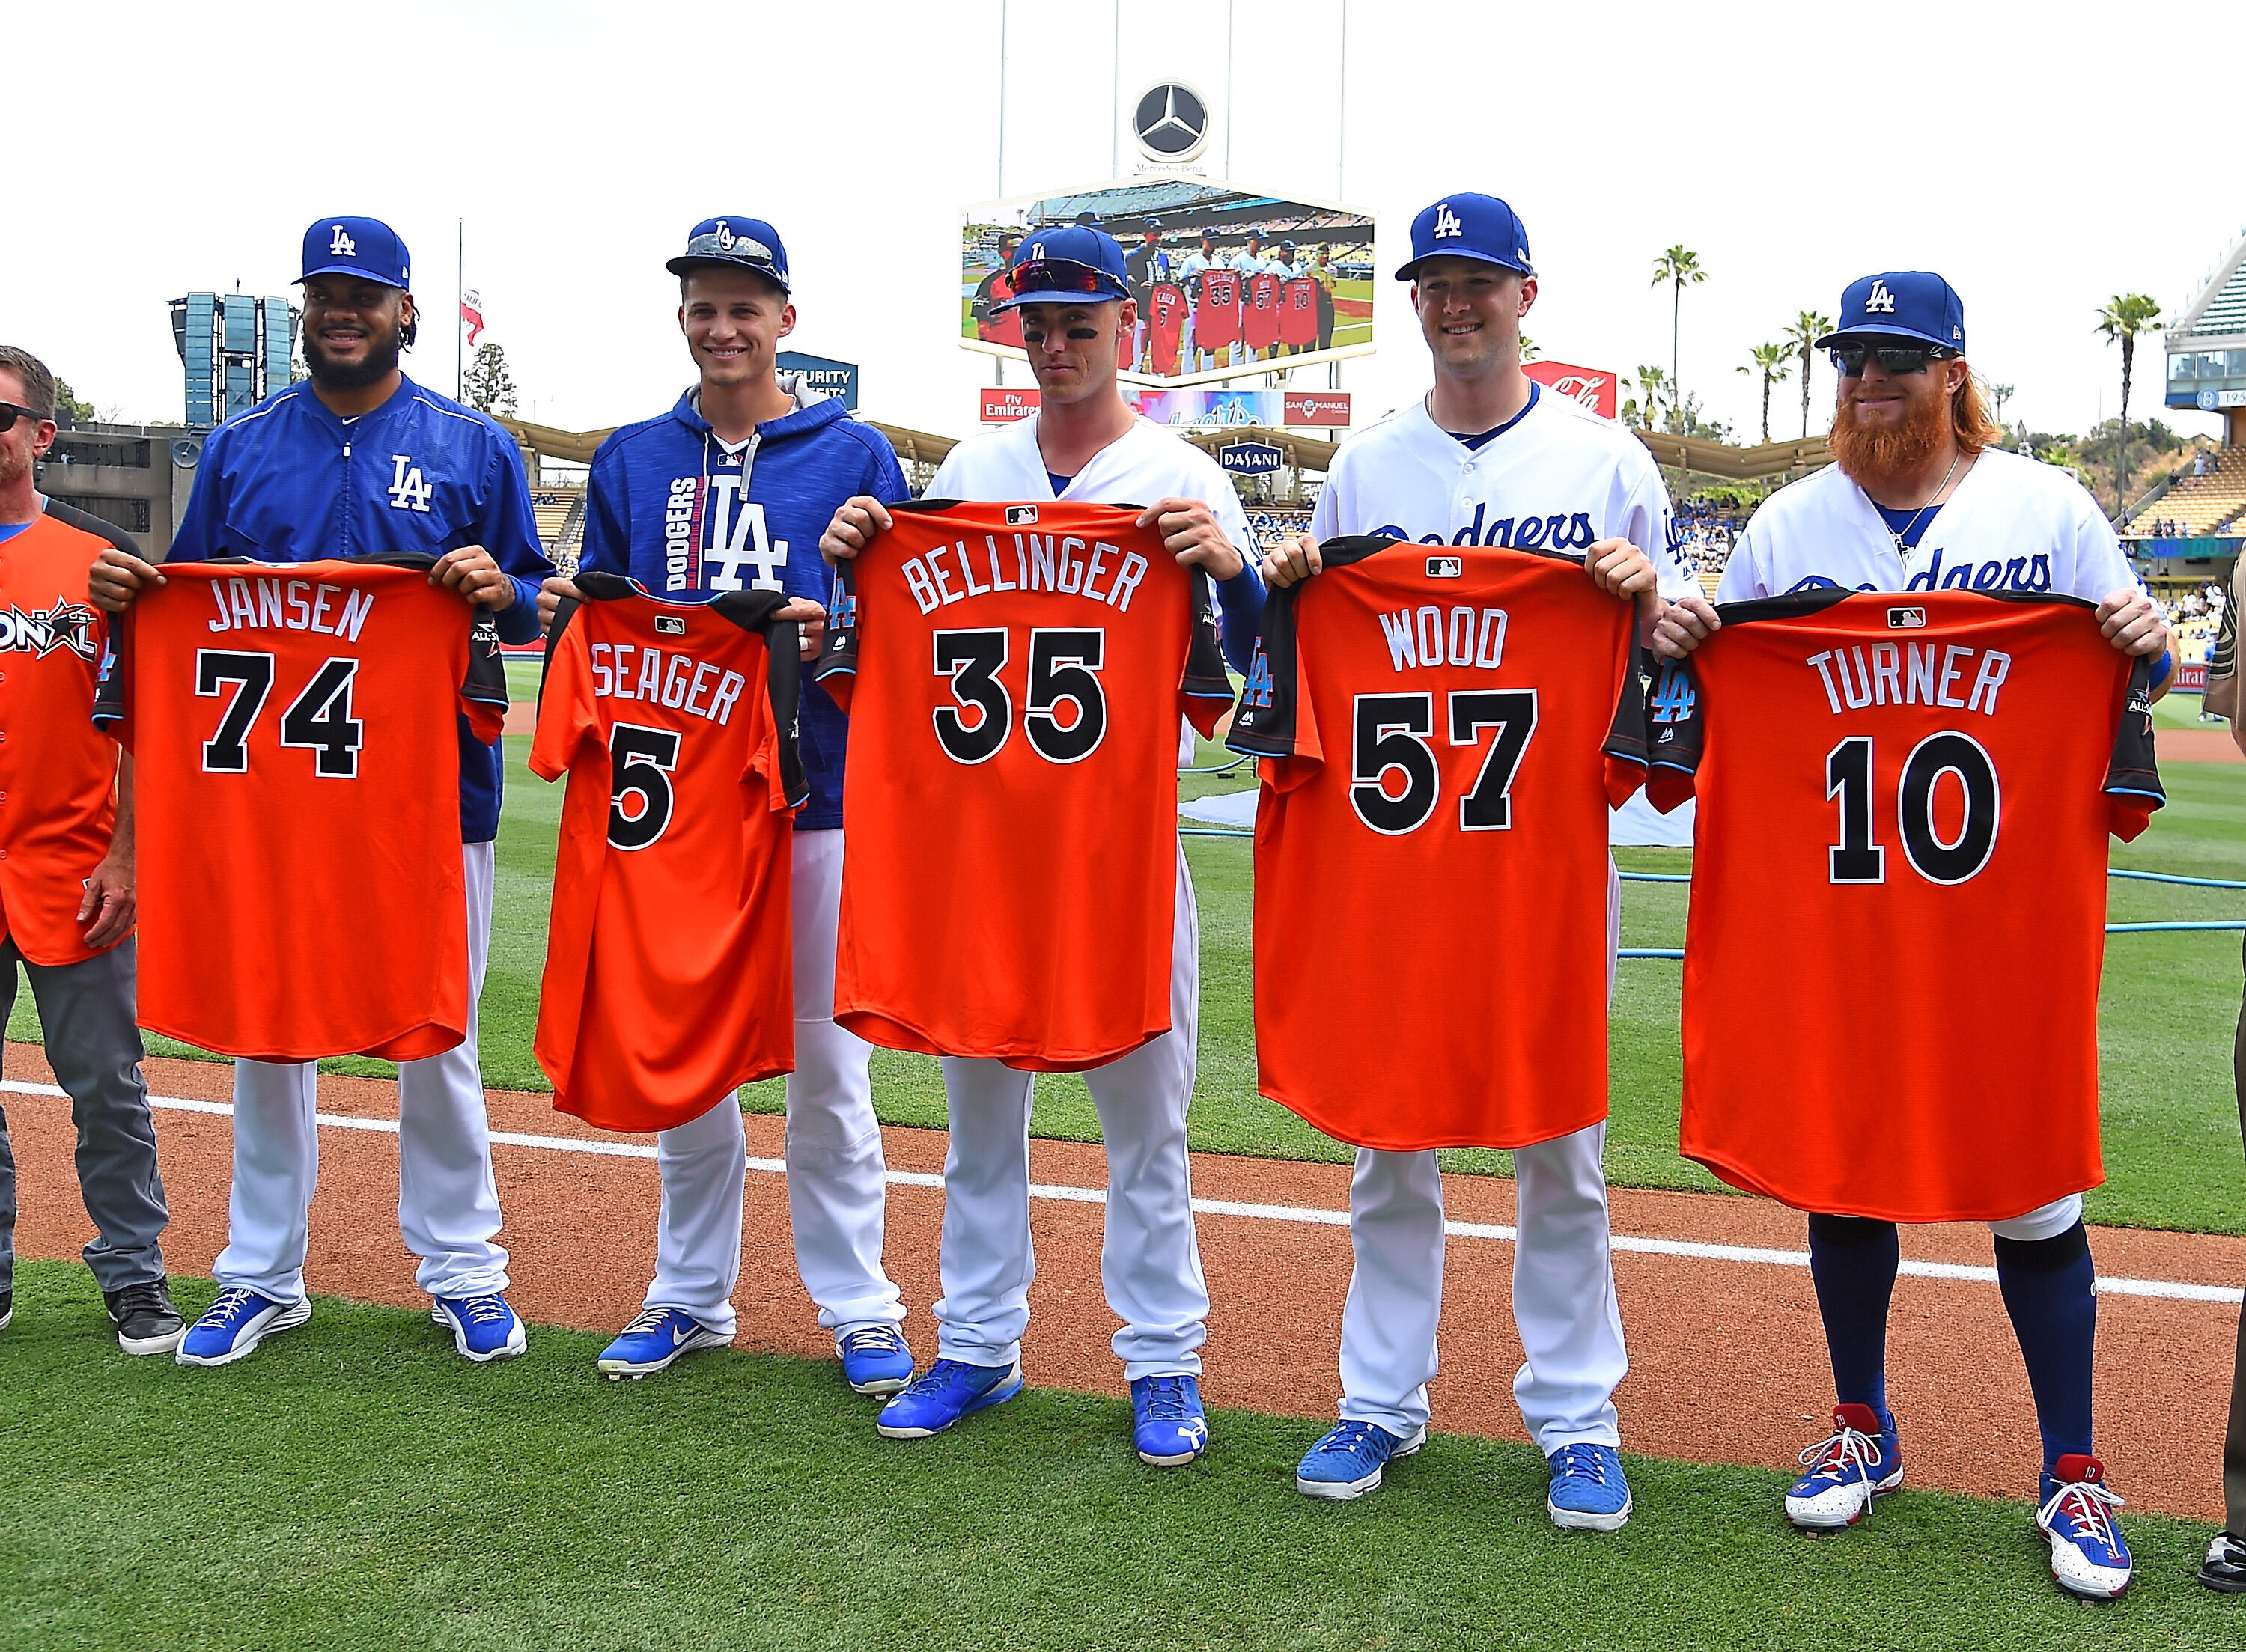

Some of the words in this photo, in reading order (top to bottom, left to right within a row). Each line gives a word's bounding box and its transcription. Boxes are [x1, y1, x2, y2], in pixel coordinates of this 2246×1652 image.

[329, 225, 356, 257] LA
[1434, 204, 1462, 239] LA
[1210, 286, 1231, 306] 35
[1256, 290, 1272, 309] 57
[1294, 293, 1309, 310] 10
[1866, 280, 1895, 313] LA
[1005, 394, 1023, 405] Fly
[387, 455, 432, 512] LA
[665, 477, 697, 591] DODGERS
[704, 475, 789, 594] LA
[901, 534, 1148, 615] BELLINGER
[209, 579, 374, 643] JANSEN
[1379, 606, 1508, 672] WOOD
[591, 643, 746, 726] SEAGER
[932, 627, 1107, 764] 35
[1651, 658, 1696, 723] LA
[1806, 641, 2011, 716] TURNER
[196, 648, 363, 778] 74
[607, 722, 682, 851] 5
[1349, 689, 1539, 835] 57
[1825, 730, 2001, 886] 10
[1836, 1414, 1845, 1426] 10
[2085, 1466, 2096, 1478] 10
